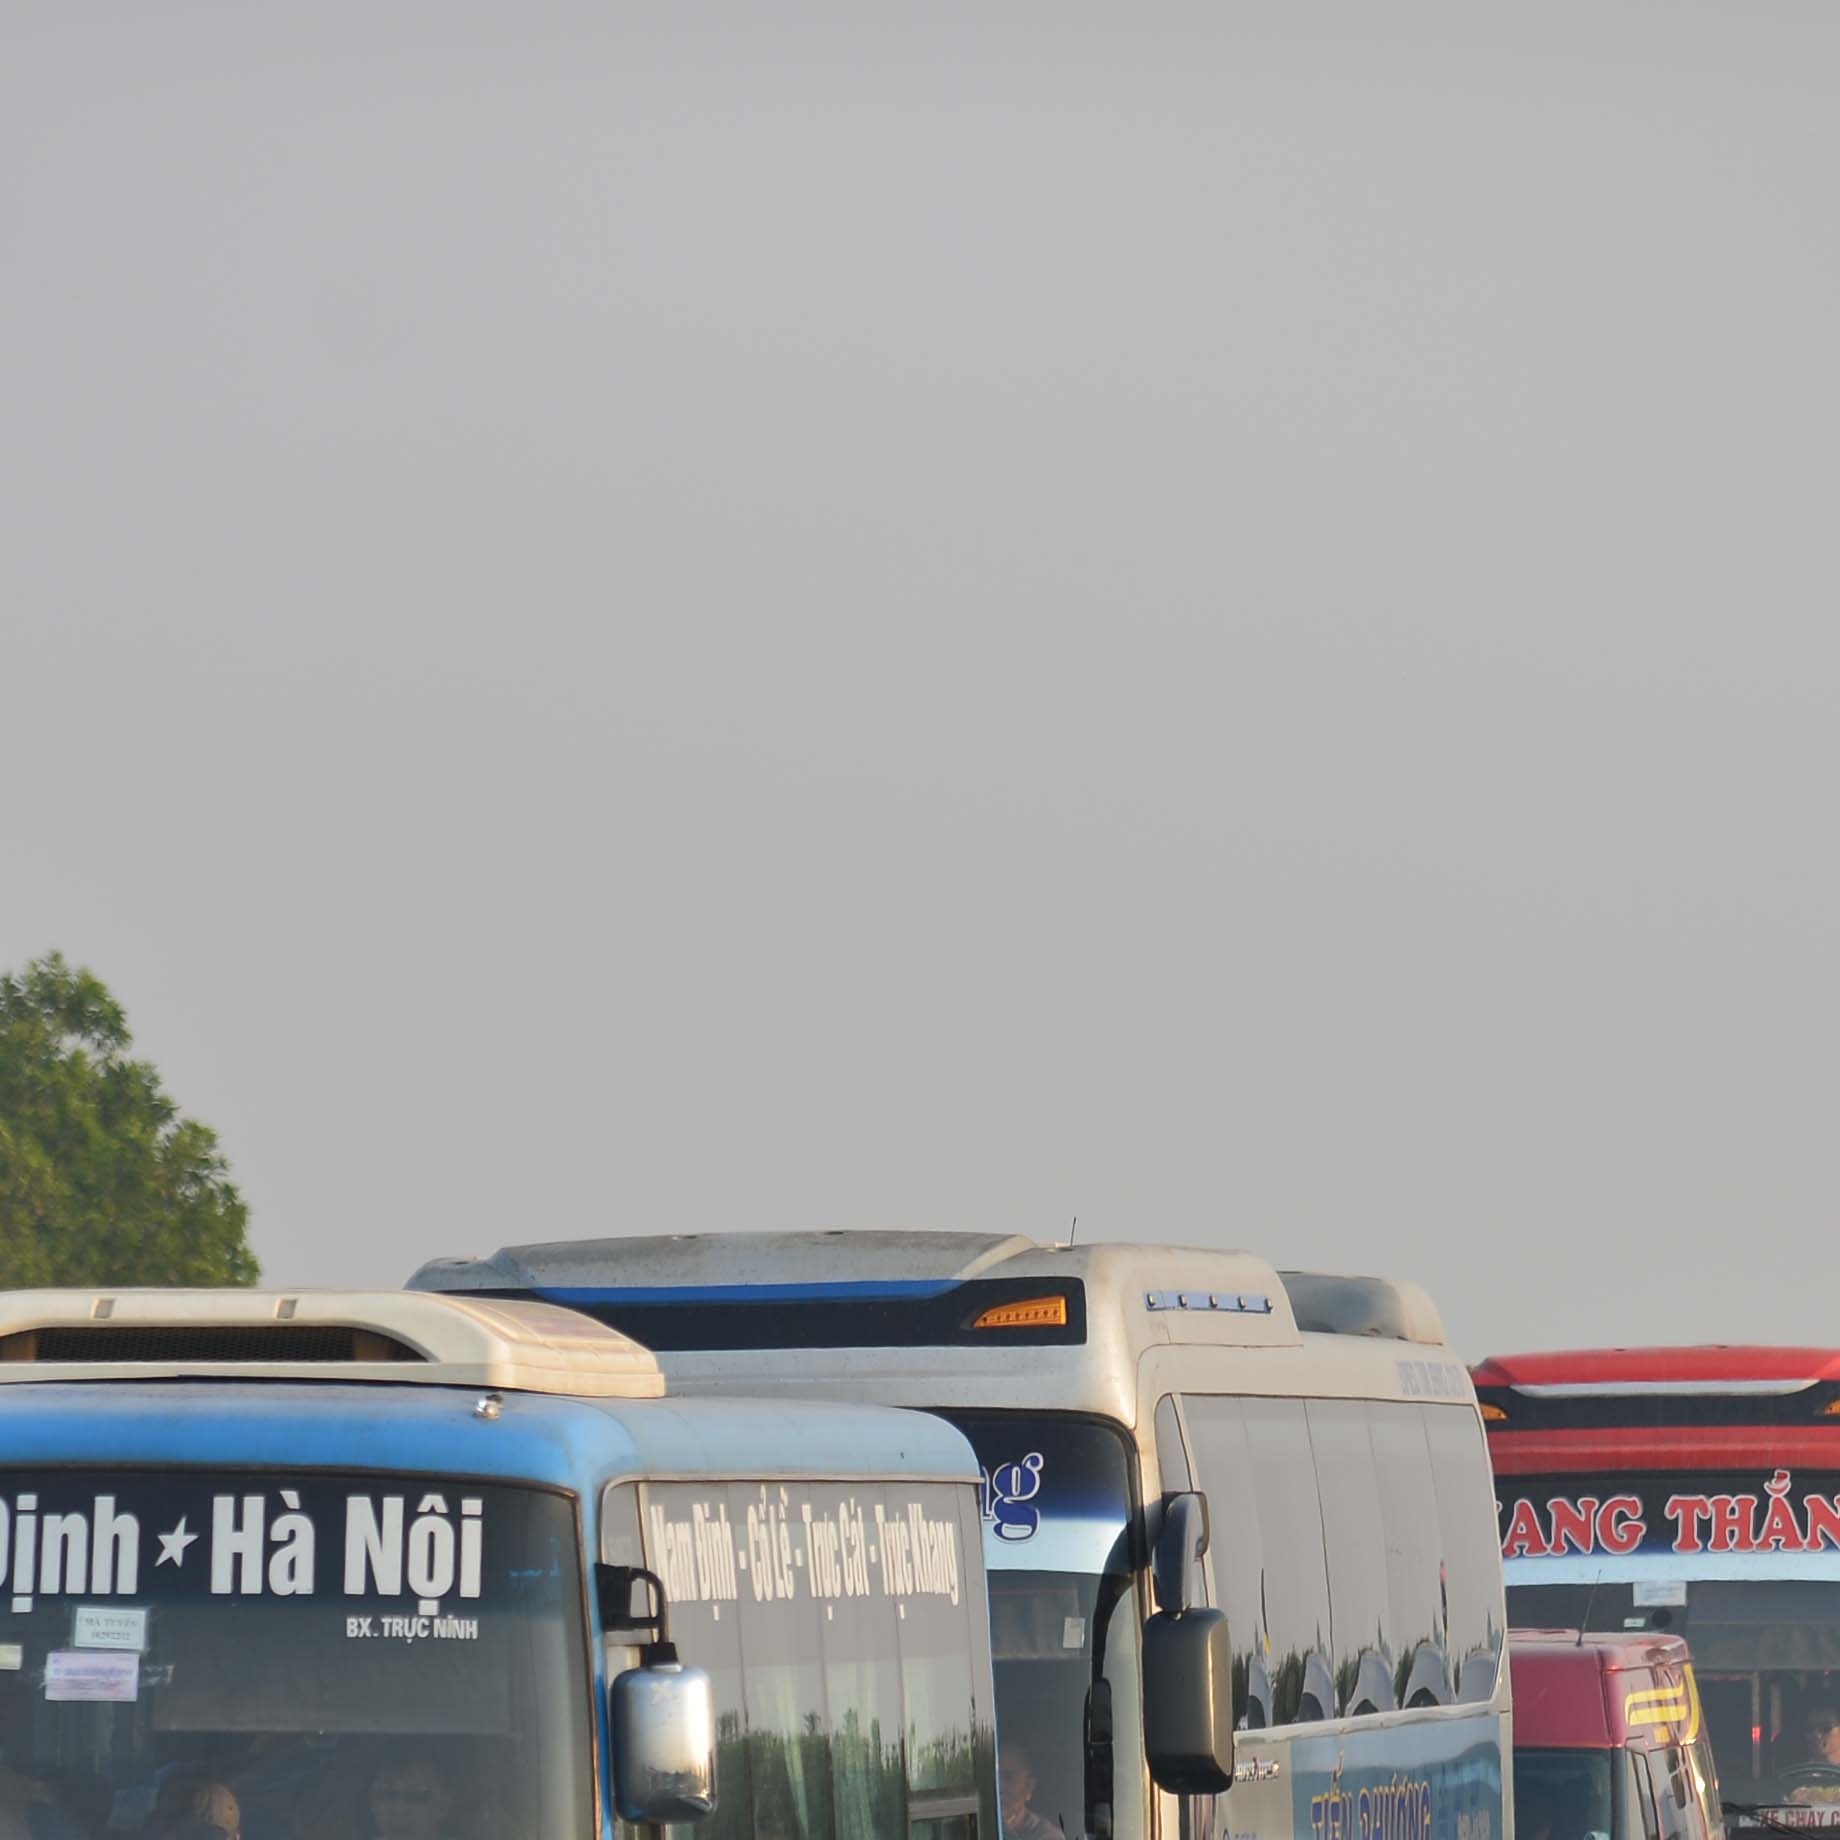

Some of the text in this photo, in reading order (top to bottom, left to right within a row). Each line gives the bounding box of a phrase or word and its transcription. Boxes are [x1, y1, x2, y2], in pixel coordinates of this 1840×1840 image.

[209, 1489, 315, 1597] Hà
[343, 1492, 484, 1616] Nội
[651, 1505, 697, 1603] Nam
[692, 1502, 739, 1622] Định
[1495, 1494, 1647, 1558] ANG
